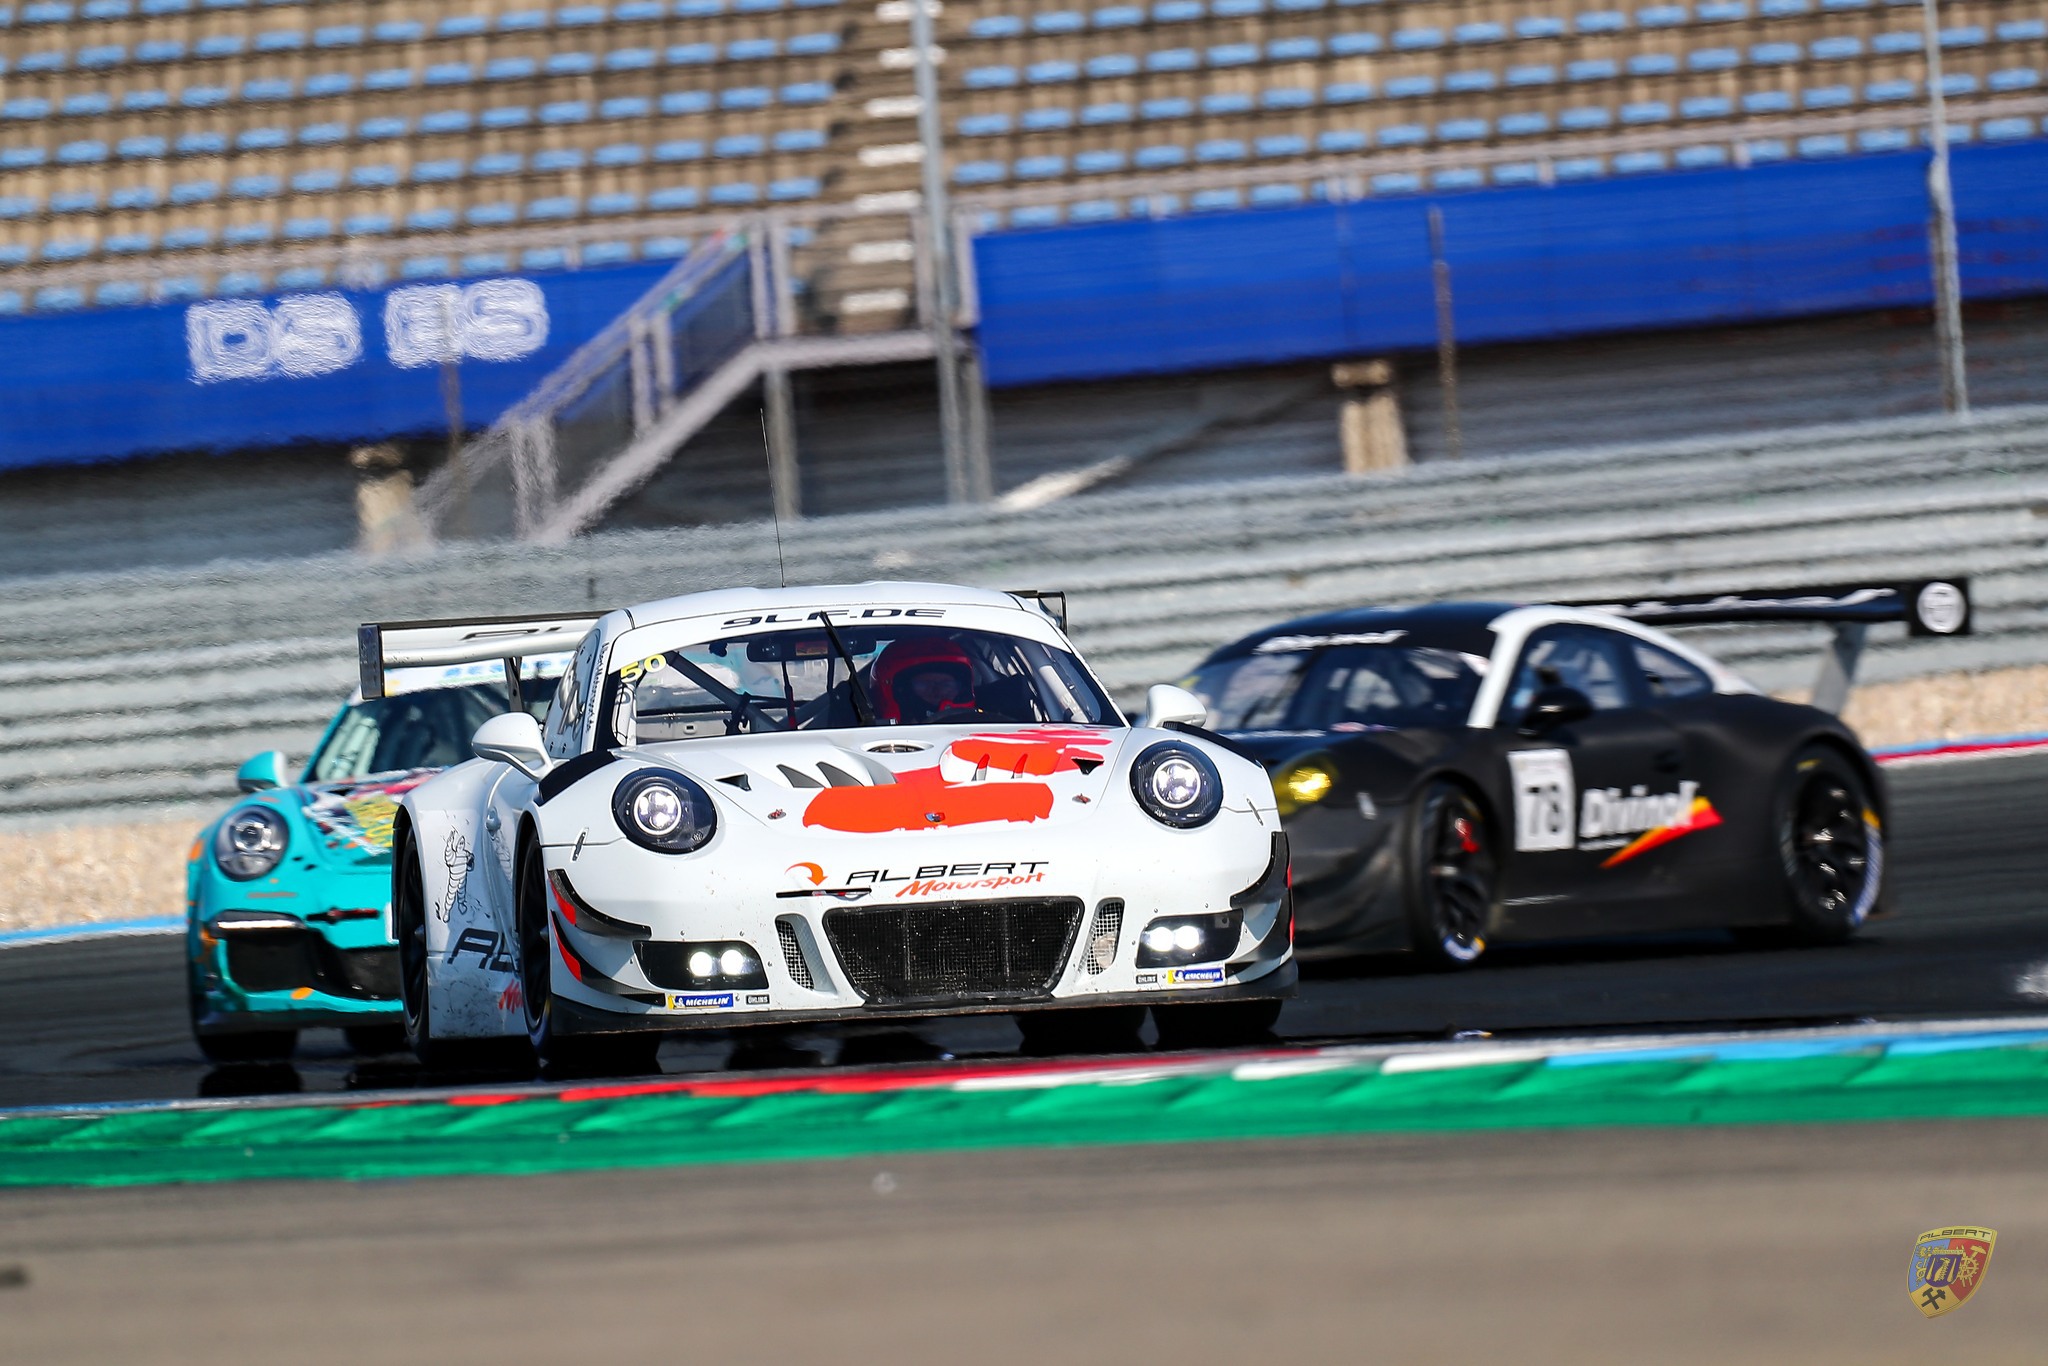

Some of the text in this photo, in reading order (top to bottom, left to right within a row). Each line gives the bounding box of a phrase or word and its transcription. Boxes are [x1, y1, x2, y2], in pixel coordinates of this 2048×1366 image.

[620, 654, 667, 684] 50
[845, 861, 1049, 885] ALBERT
[685, 996, 730, 1006] MICHELIN
